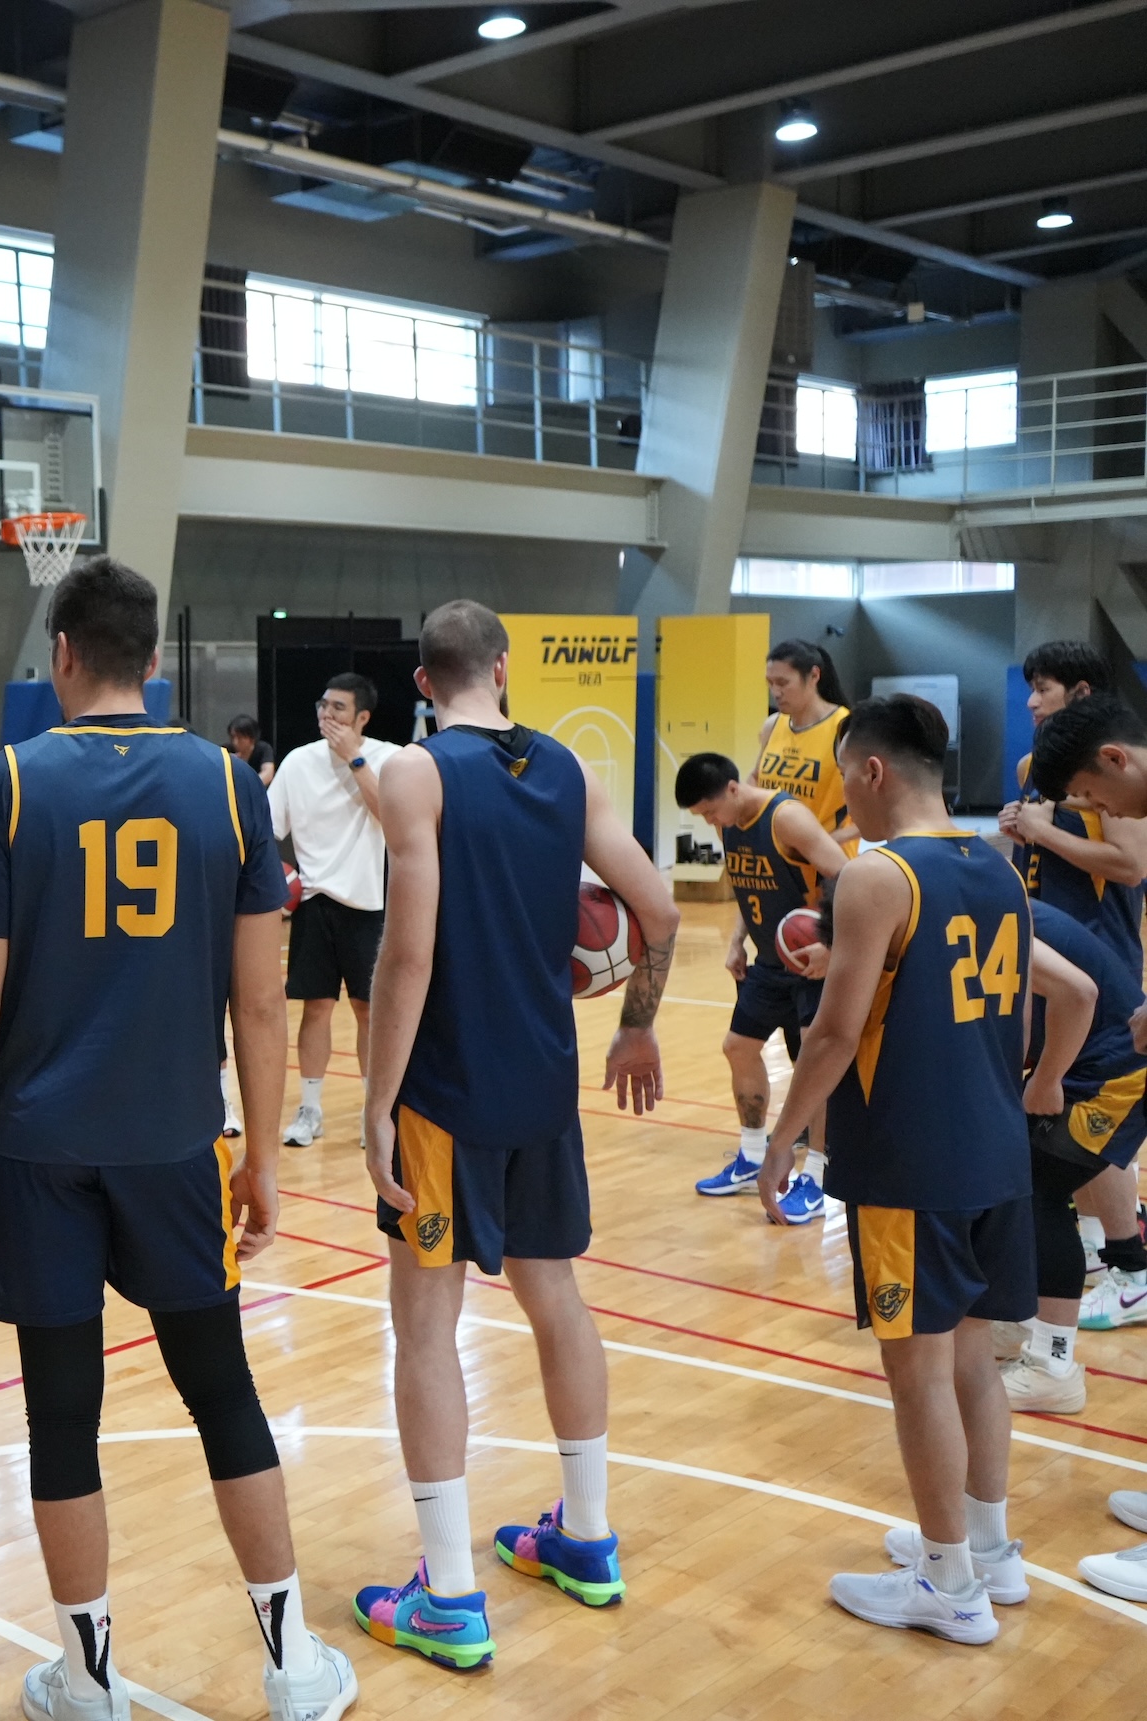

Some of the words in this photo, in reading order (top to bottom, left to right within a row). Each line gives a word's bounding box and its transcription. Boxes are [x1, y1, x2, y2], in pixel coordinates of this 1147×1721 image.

[762, 751, 820, 783] DEA
[78, 817, 178, 938] 19
[726, 851, 774, 877] DEA
[748, 894, 763, 925] 3
[945, 913, 1021, 1023] 24
